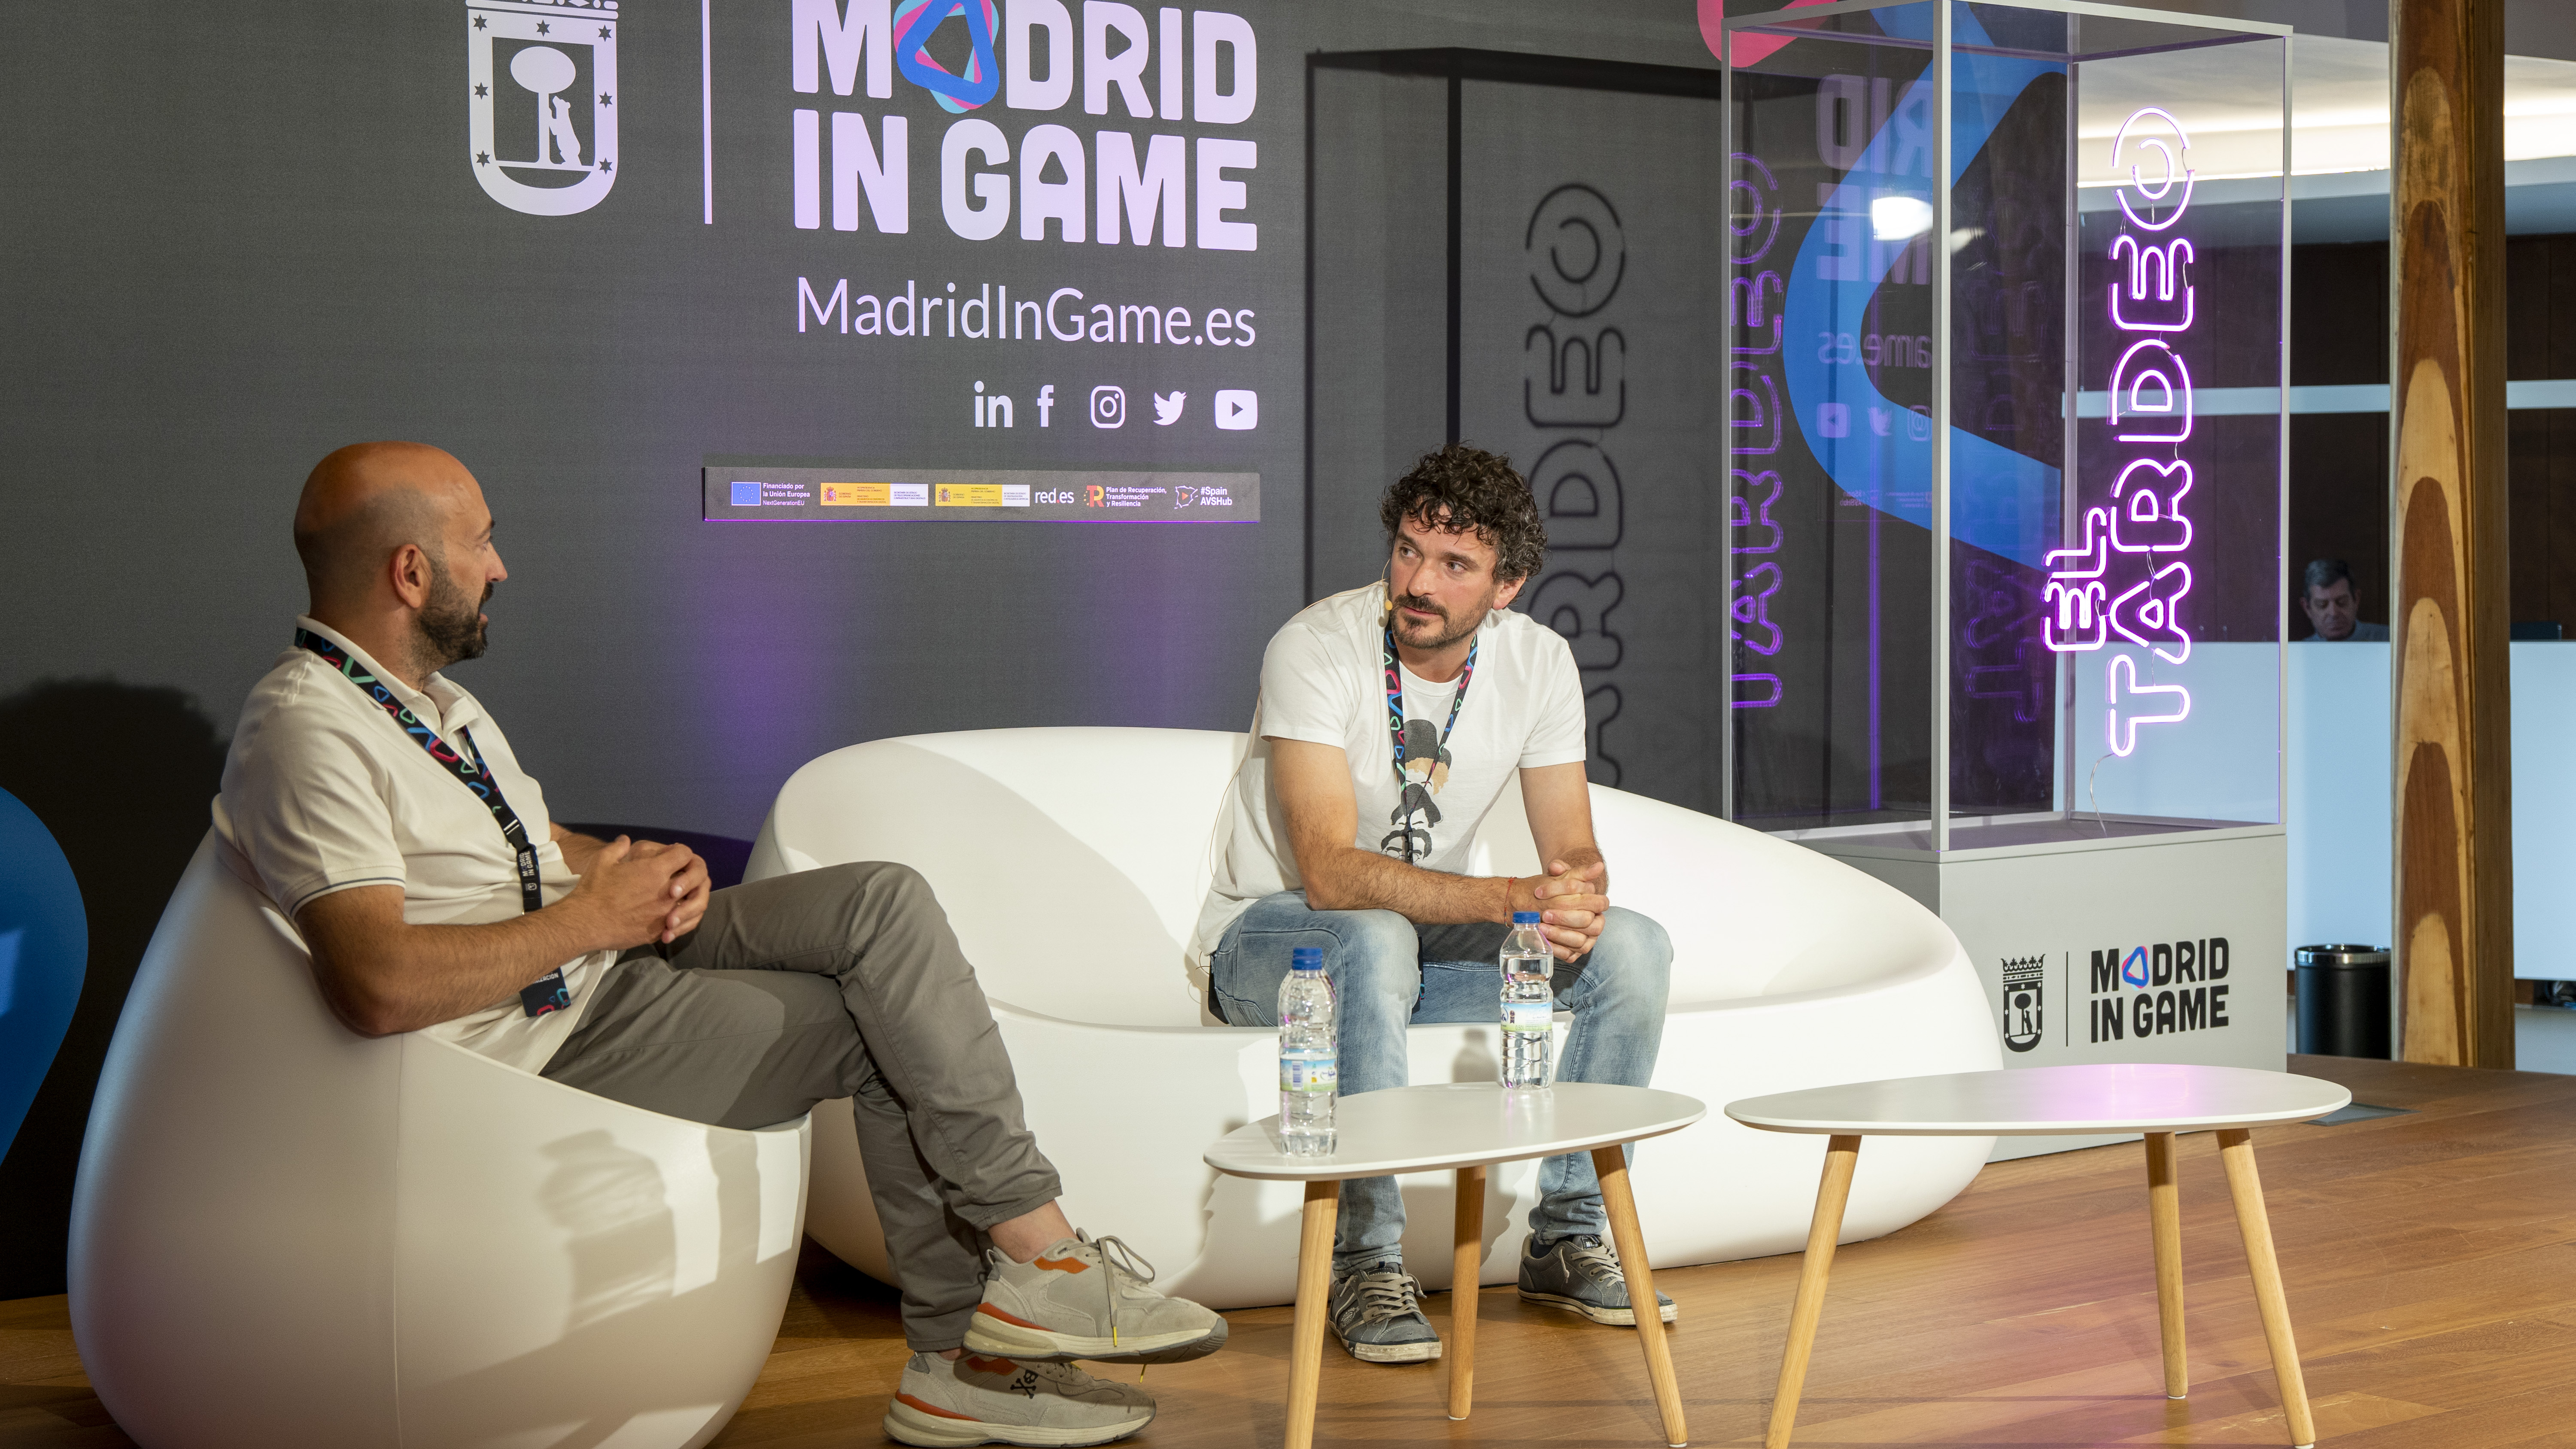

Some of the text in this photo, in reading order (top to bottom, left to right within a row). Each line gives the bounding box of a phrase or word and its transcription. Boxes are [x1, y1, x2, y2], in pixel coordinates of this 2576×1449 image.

[793, 109, 1257, 251] IN GAME
[798, 277, 1255, 346] MadridInGame.es
[2106, 106, 2194, 758] TARDEO
[1035, 488, 1074, 504] red.es
[1200, 486, 1227, 497] #Spain
[1200, 497, 1233, 506] AVSHub
[2043, 506, 2107, 652] EL
[524, 851, 533, 868] GAME
[2091, 985, 2229, 1043] IN GAME
